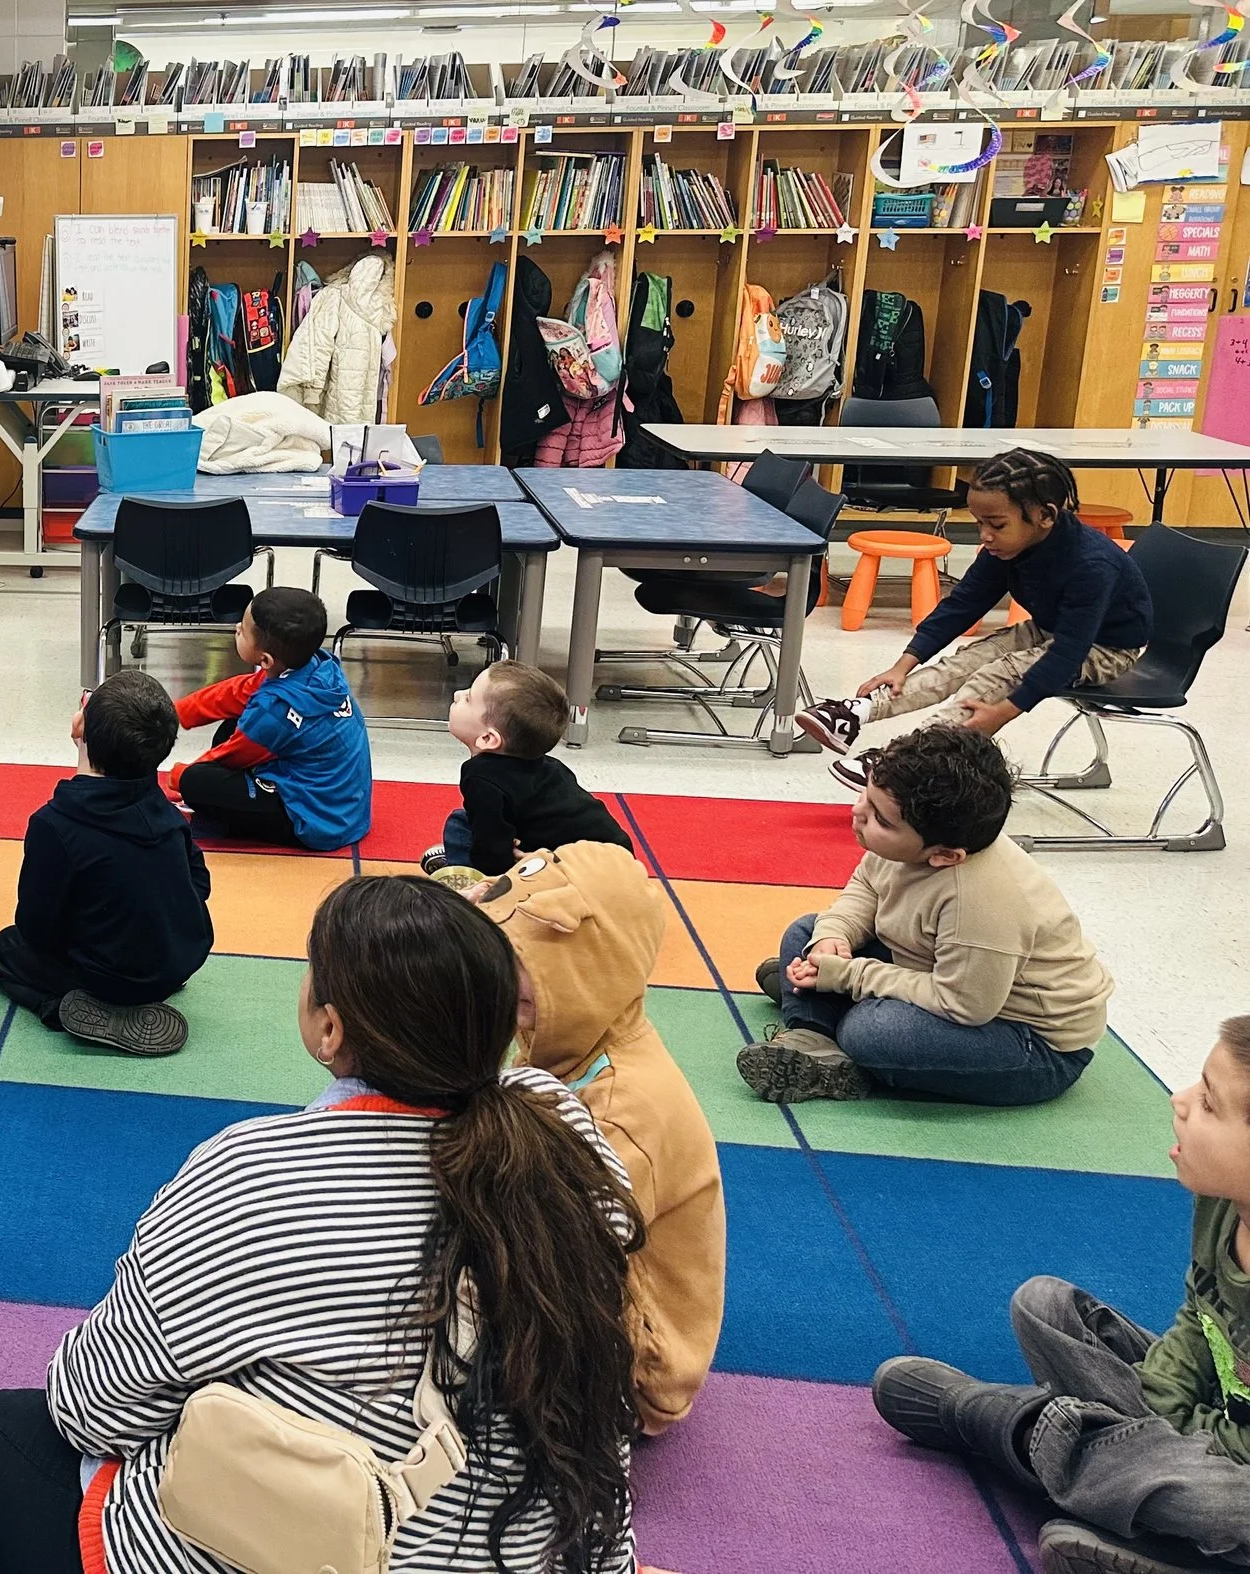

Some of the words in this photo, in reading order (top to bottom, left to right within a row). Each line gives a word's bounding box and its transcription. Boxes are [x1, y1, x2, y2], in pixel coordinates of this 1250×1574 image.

[1189, 188, 1225, 201] READING
[74, 223, 83, 235] I
[89, 224, 105, 234] can
[1182, 227, 1221, 239] SPECIALS
[90, 237, 106, 245] read
[1187, 246, 1211, 257] MATH
[1182, 267, 1210, 278] LUNCH
[1169, 287, 1211, 300] HEGGERTY
[1171, 308, 1208, 317] FUNDATIONS
[780, 322, 817, 340] Hurley
[1172, 326, 1203, 338] RECESS
[1167, 364, 1197, 376] SNACK
[1158, 402, 1181, 413] PACK
[1182, 402, 1195, 413] UP
